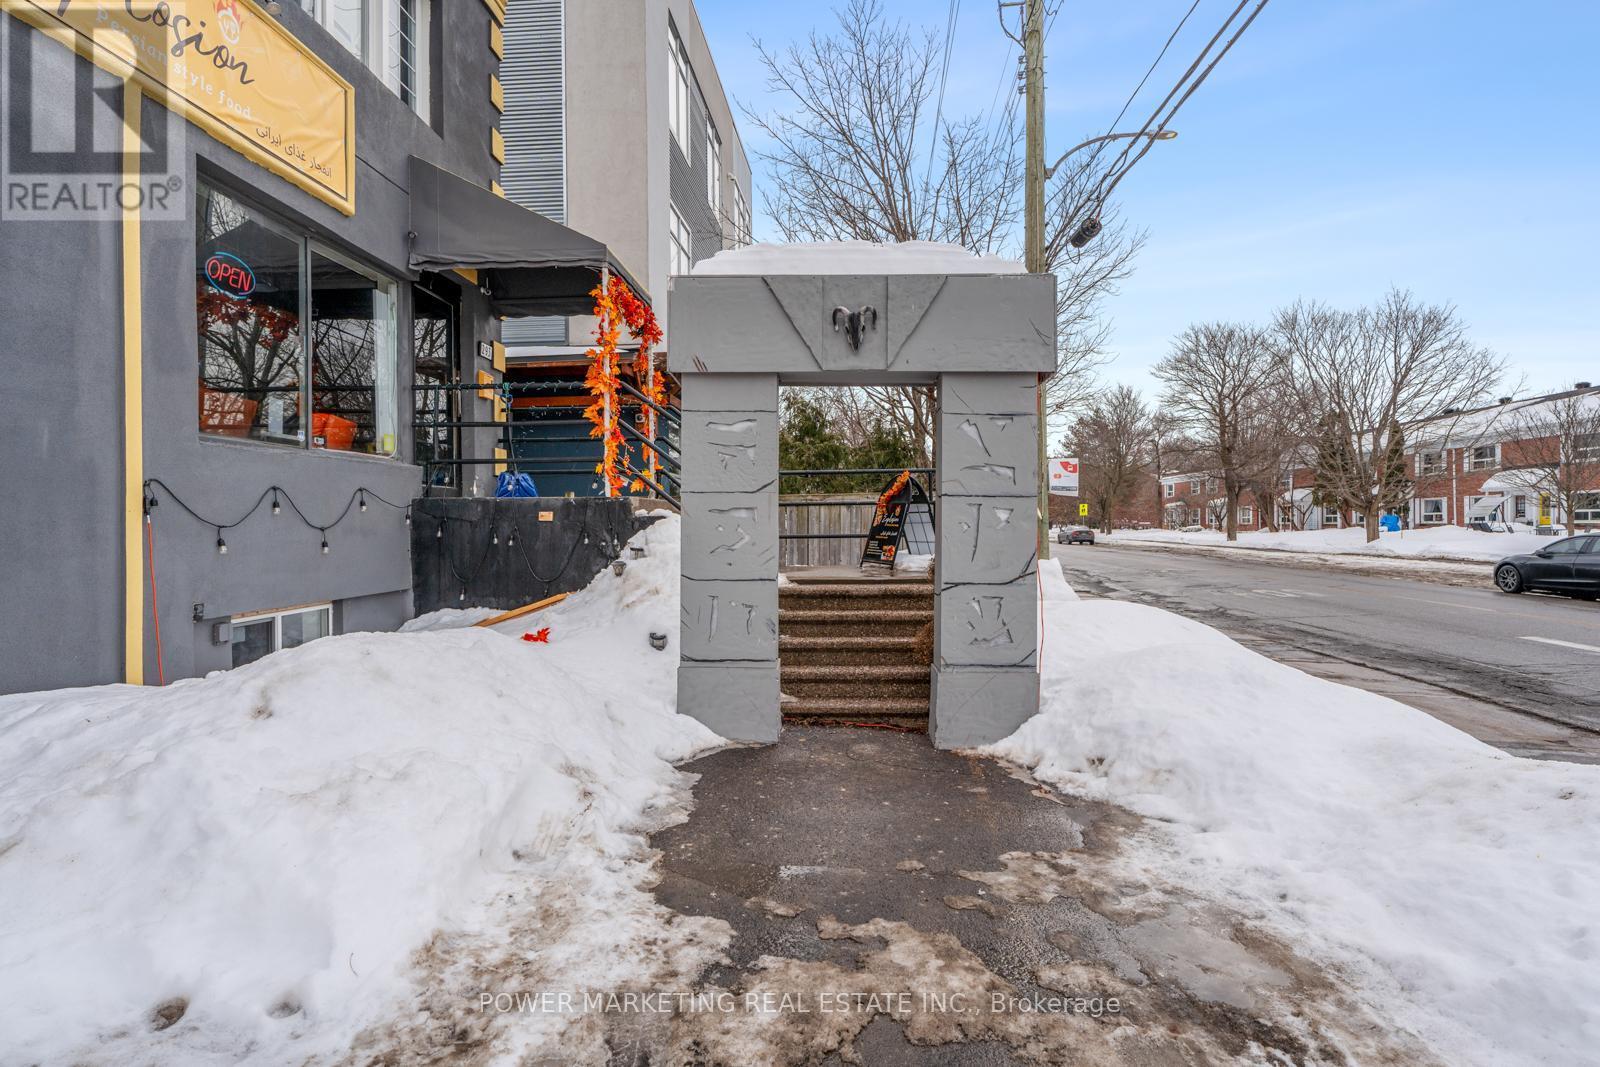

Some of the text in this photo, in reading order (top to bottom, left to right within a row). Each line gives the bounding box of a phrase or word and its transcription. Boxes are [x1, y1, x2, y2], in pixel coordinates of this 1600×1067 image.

[173, 62, 213, 95] style
[218, 91, 251, 118] food
[256, 126, 282, 146] ایرانی
[285, 143, 306, 162] غذای
[208, 259, 252, 291] OPEN
